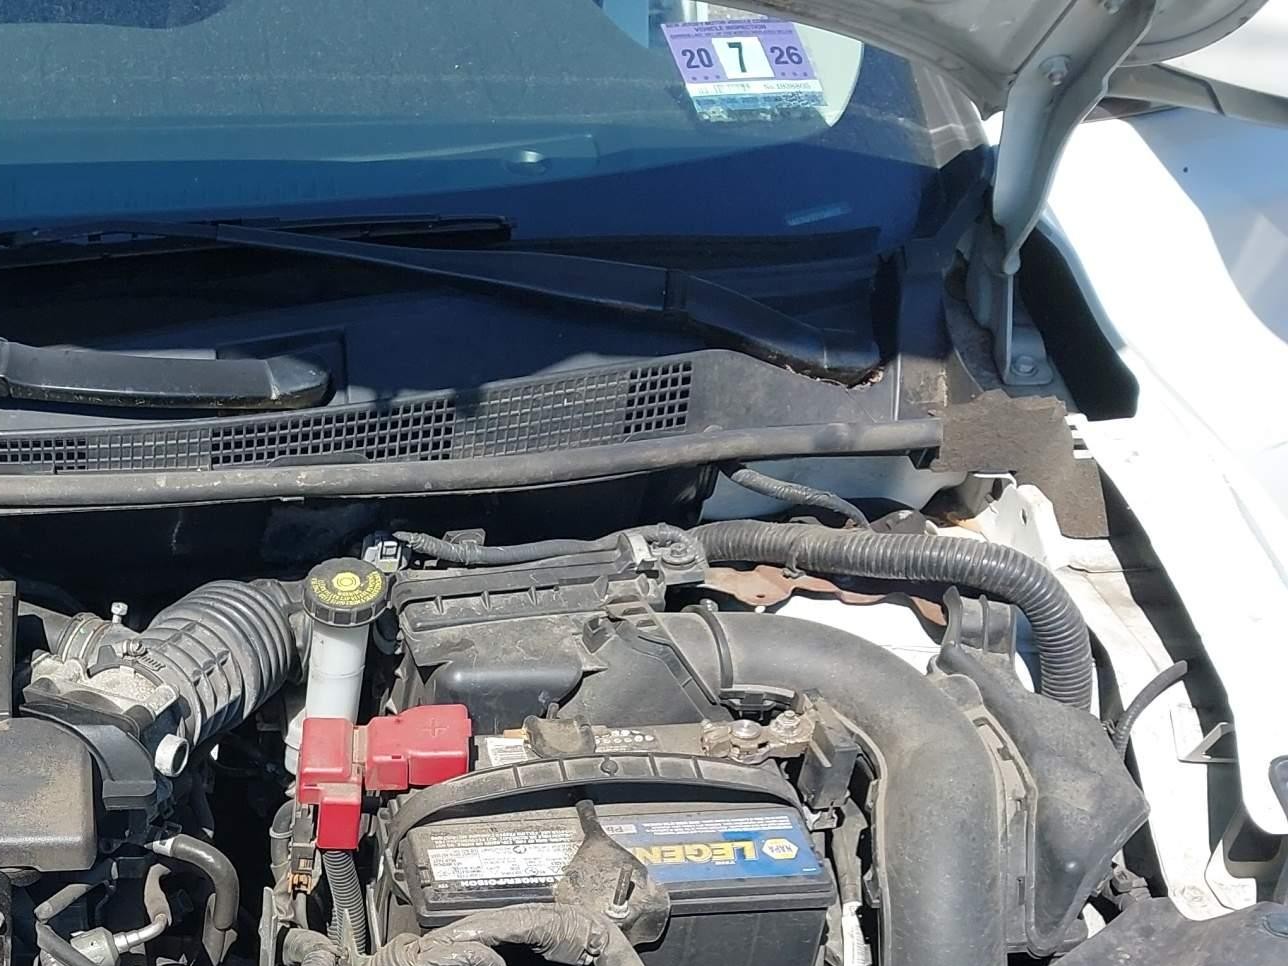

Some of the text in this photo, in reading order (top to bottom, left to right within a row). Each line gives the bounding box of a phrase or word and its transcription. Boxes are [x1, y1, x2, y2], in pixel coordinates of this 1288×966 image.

[682, 42, 803, 73] 20 7 26
[632, 839, 757, 865] LEGEN
